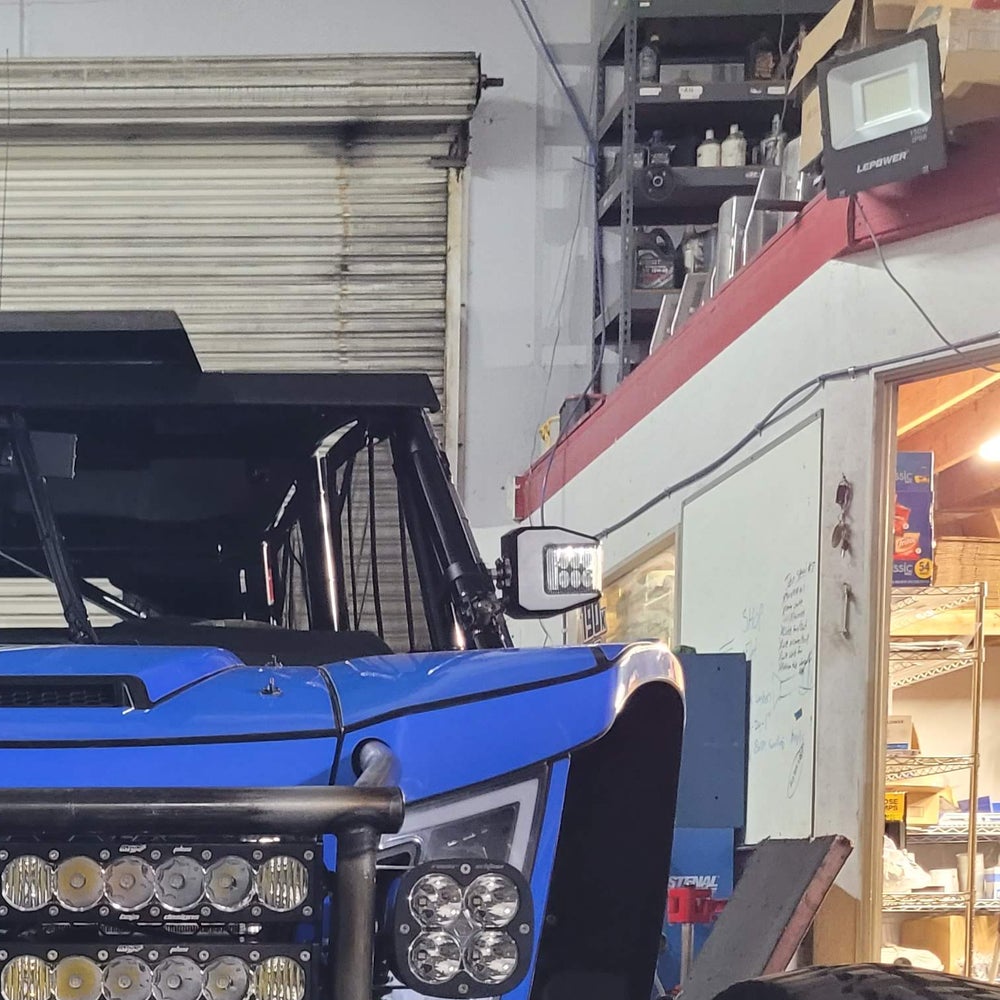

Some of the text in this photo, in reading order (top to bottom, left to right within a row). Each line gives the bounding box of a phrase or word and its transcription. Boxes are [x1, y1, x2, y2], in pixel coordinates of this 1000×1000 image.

[856, 150, 908, 174] LEPOWER
[893, 562, 913, 573] ssic
[668, 876, 718, 889] STENAL
